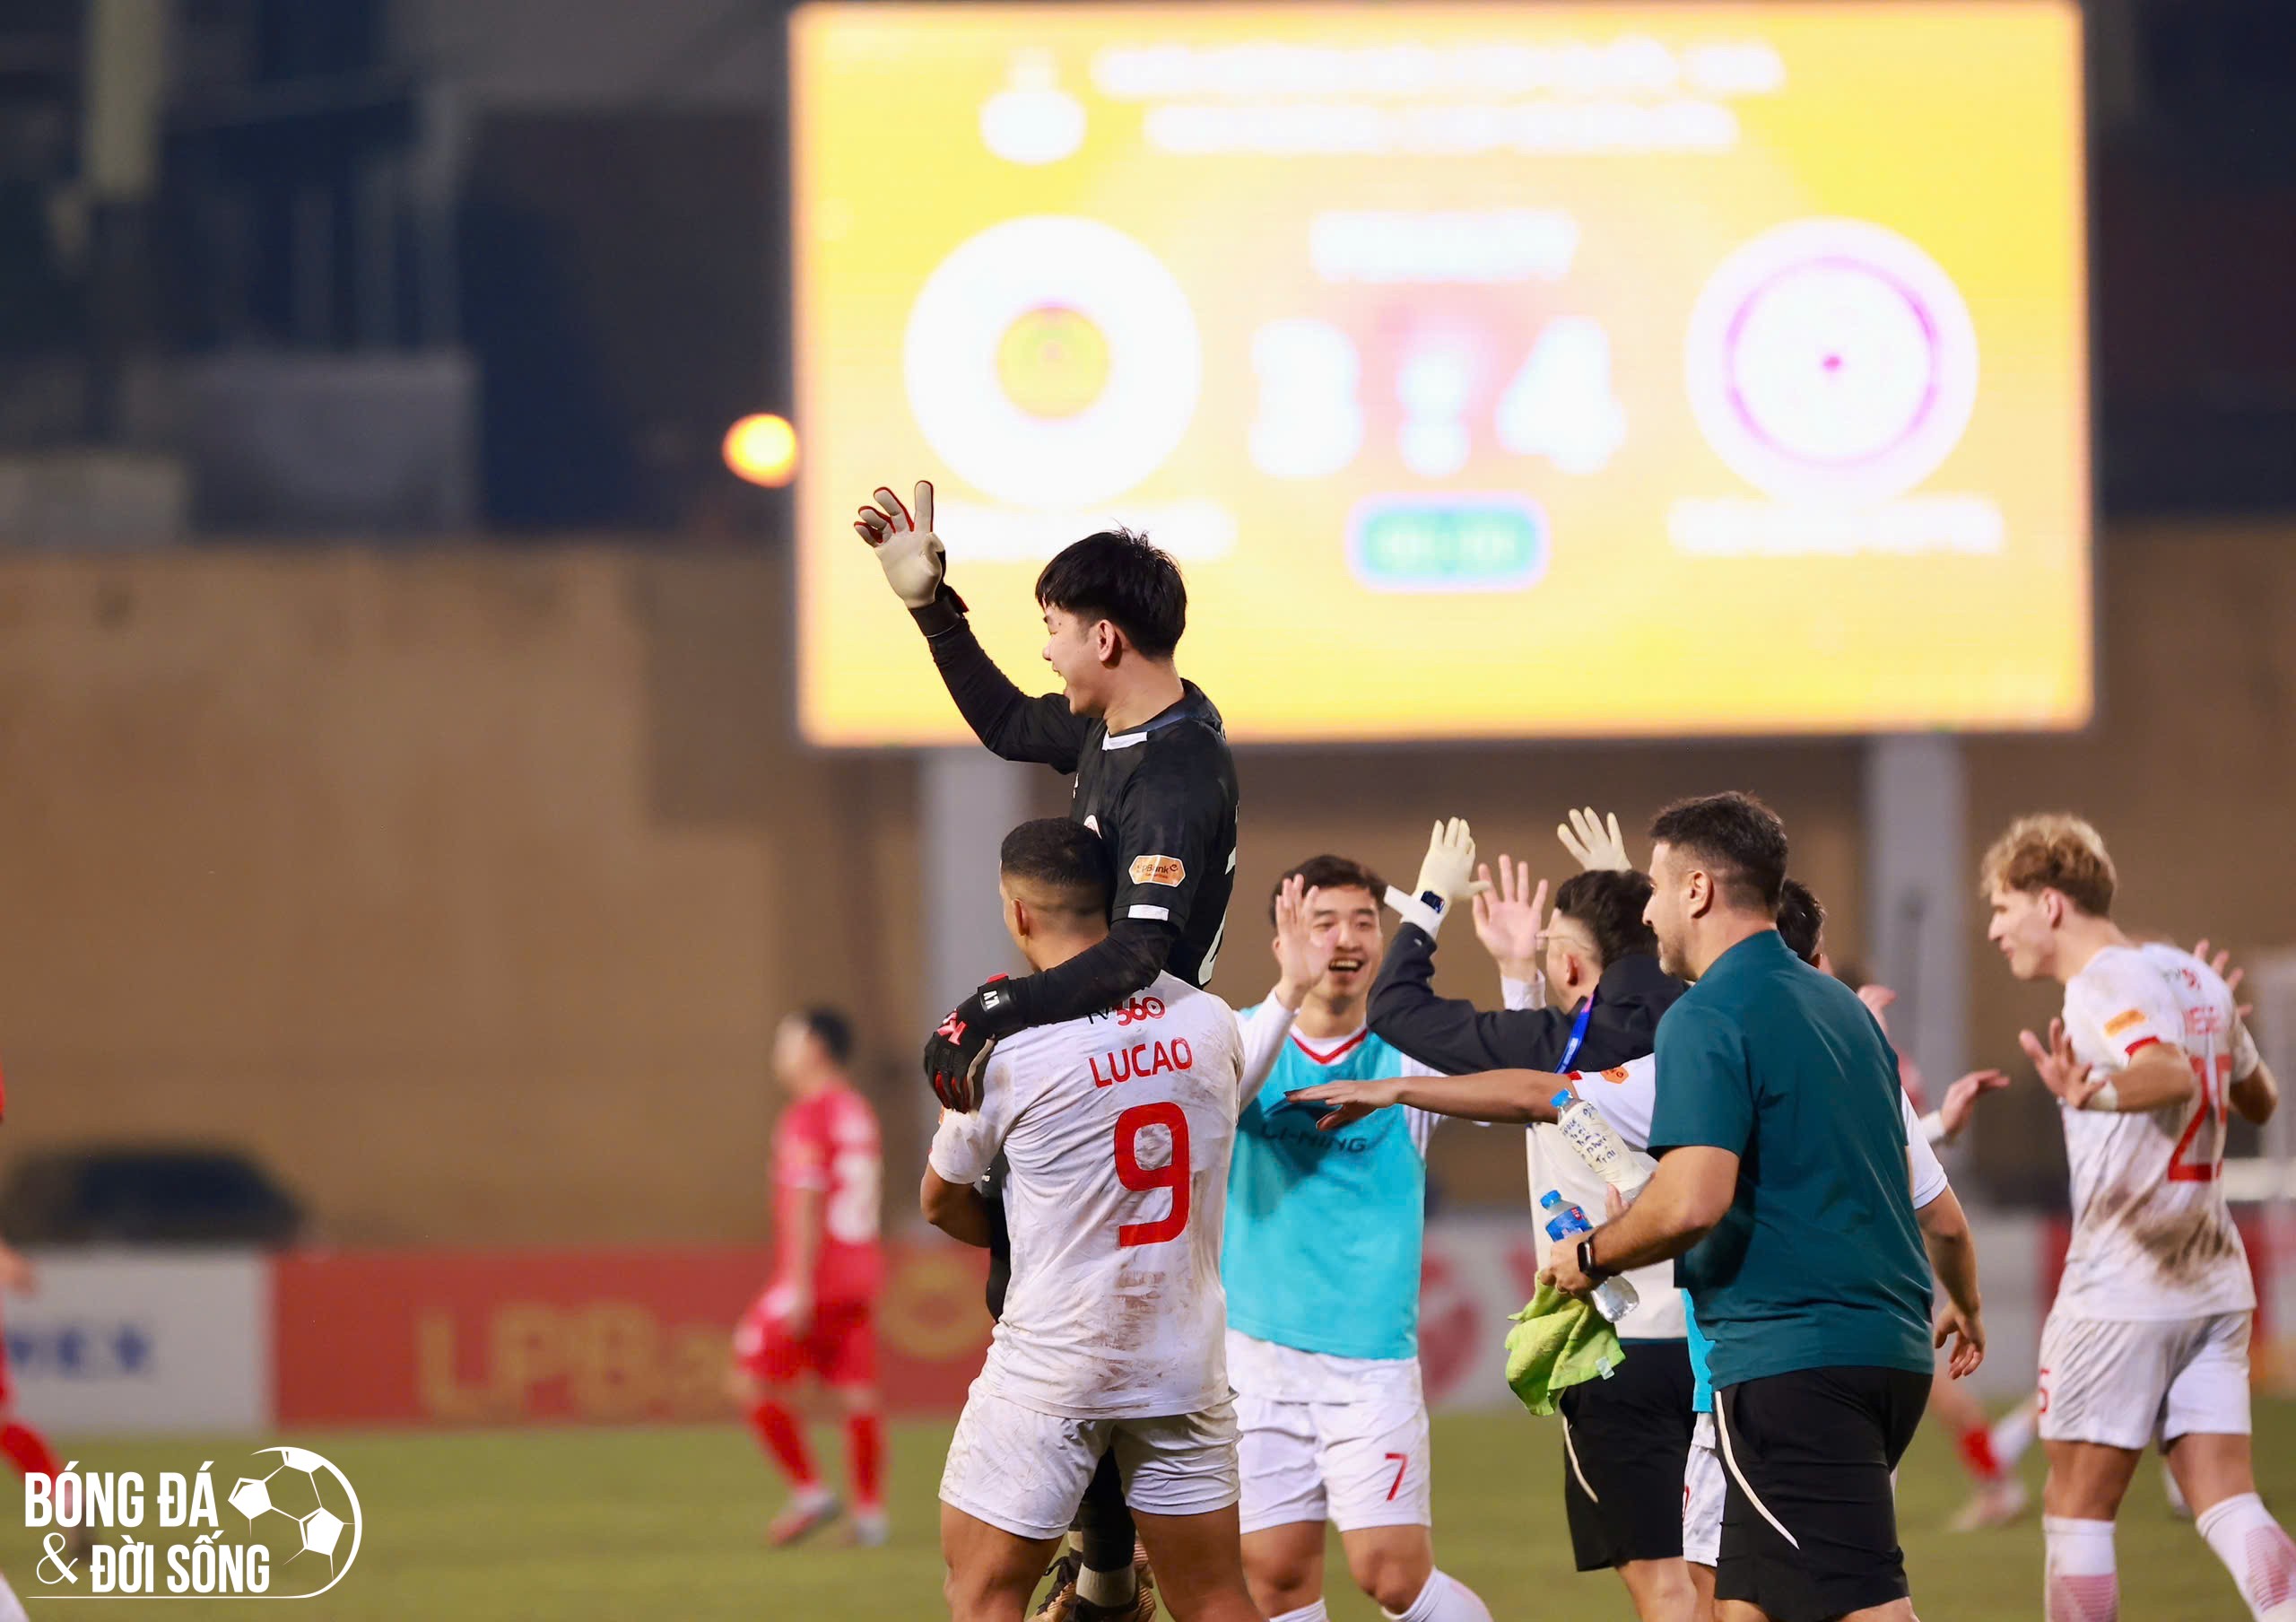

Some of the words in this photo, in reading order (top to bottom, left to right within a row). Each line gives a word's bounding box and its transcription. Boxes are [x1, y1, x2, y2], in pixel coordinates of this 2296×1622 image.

[1497, 316, 1626, 475] 4
[1088, 1037, 1193, 1088] LUCAO
[1114, 1102, 1190, 1247] 9
[1385, 1452, 1408, 1501] 7
